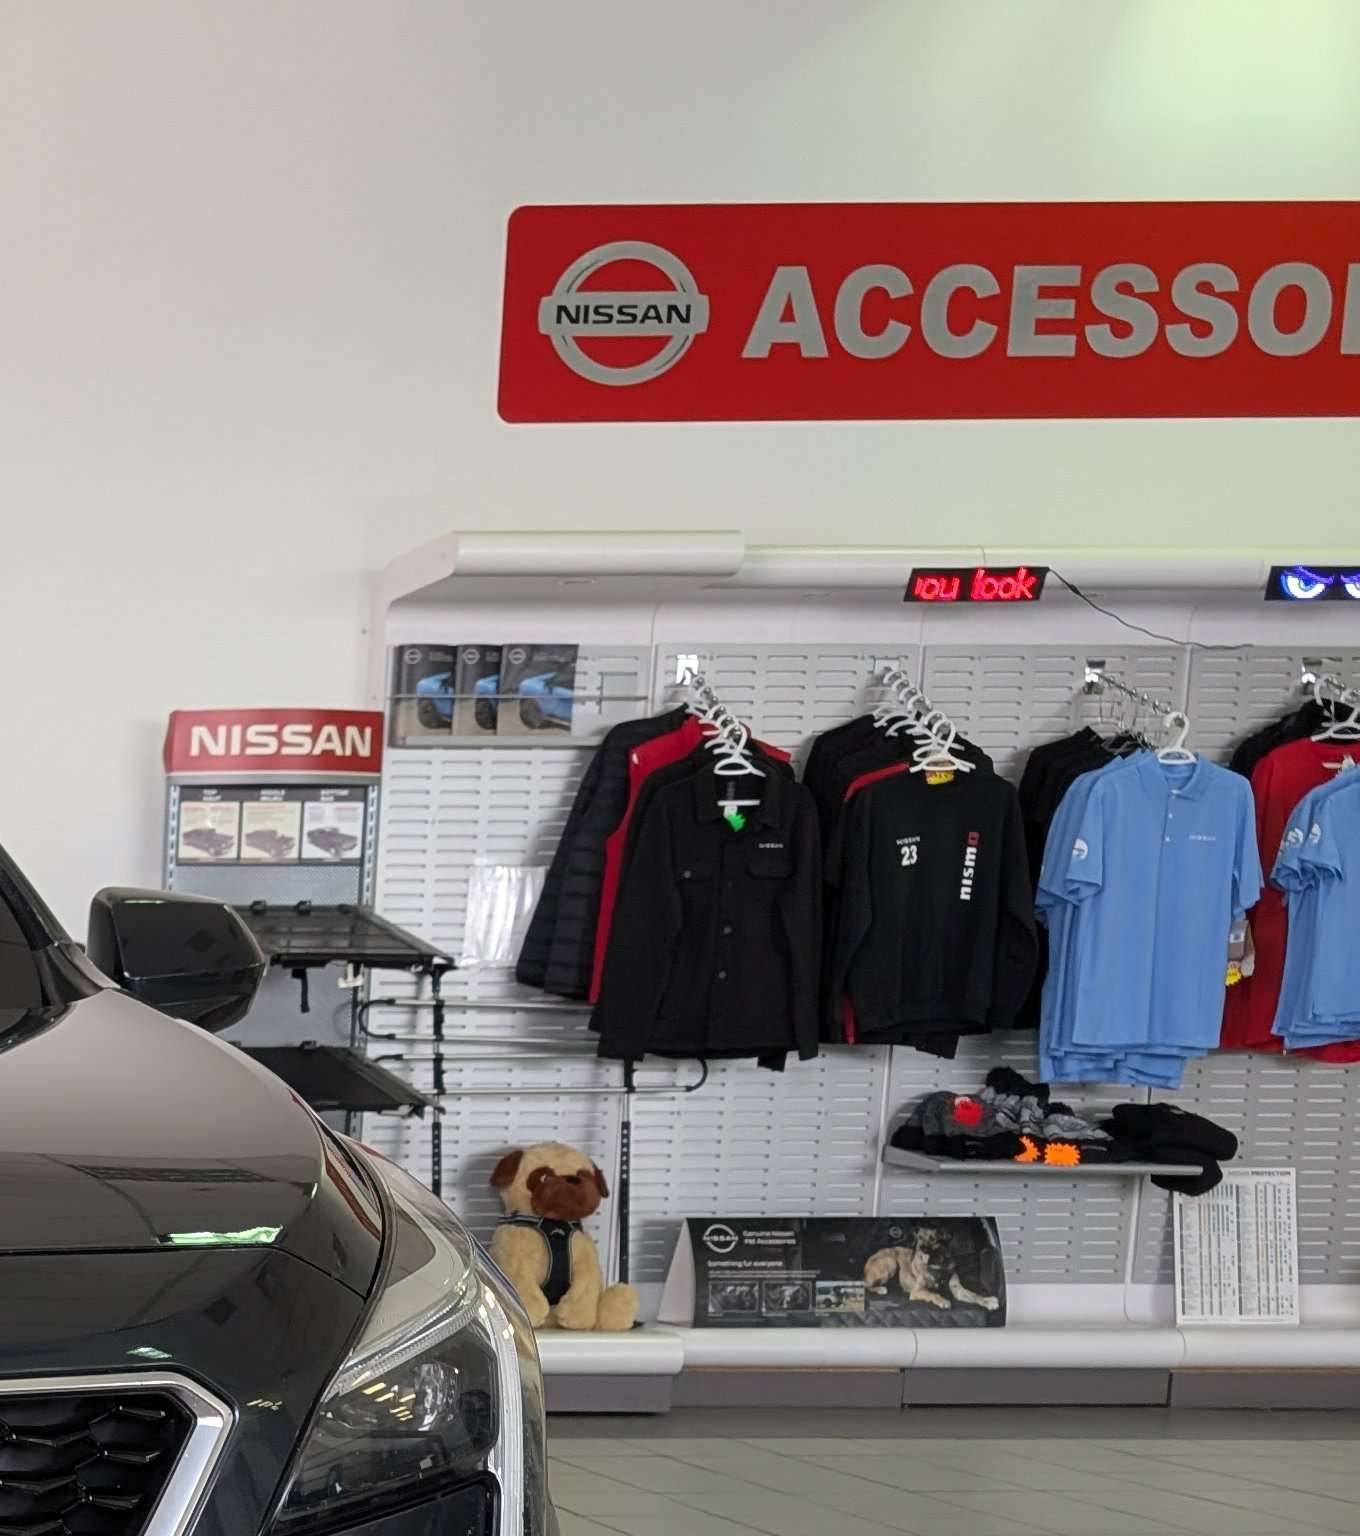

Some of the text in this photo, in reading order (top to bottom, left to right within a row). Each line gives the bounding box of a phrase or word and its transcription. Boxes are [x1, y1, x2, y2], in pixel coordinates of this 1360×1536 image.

[555, 303, 693, 325] NISSAN
[741, 262, 1360, 359] ACCESSO
[189, 723, 373, 758] NISSAN
[900, 844, 918, 867] 23
